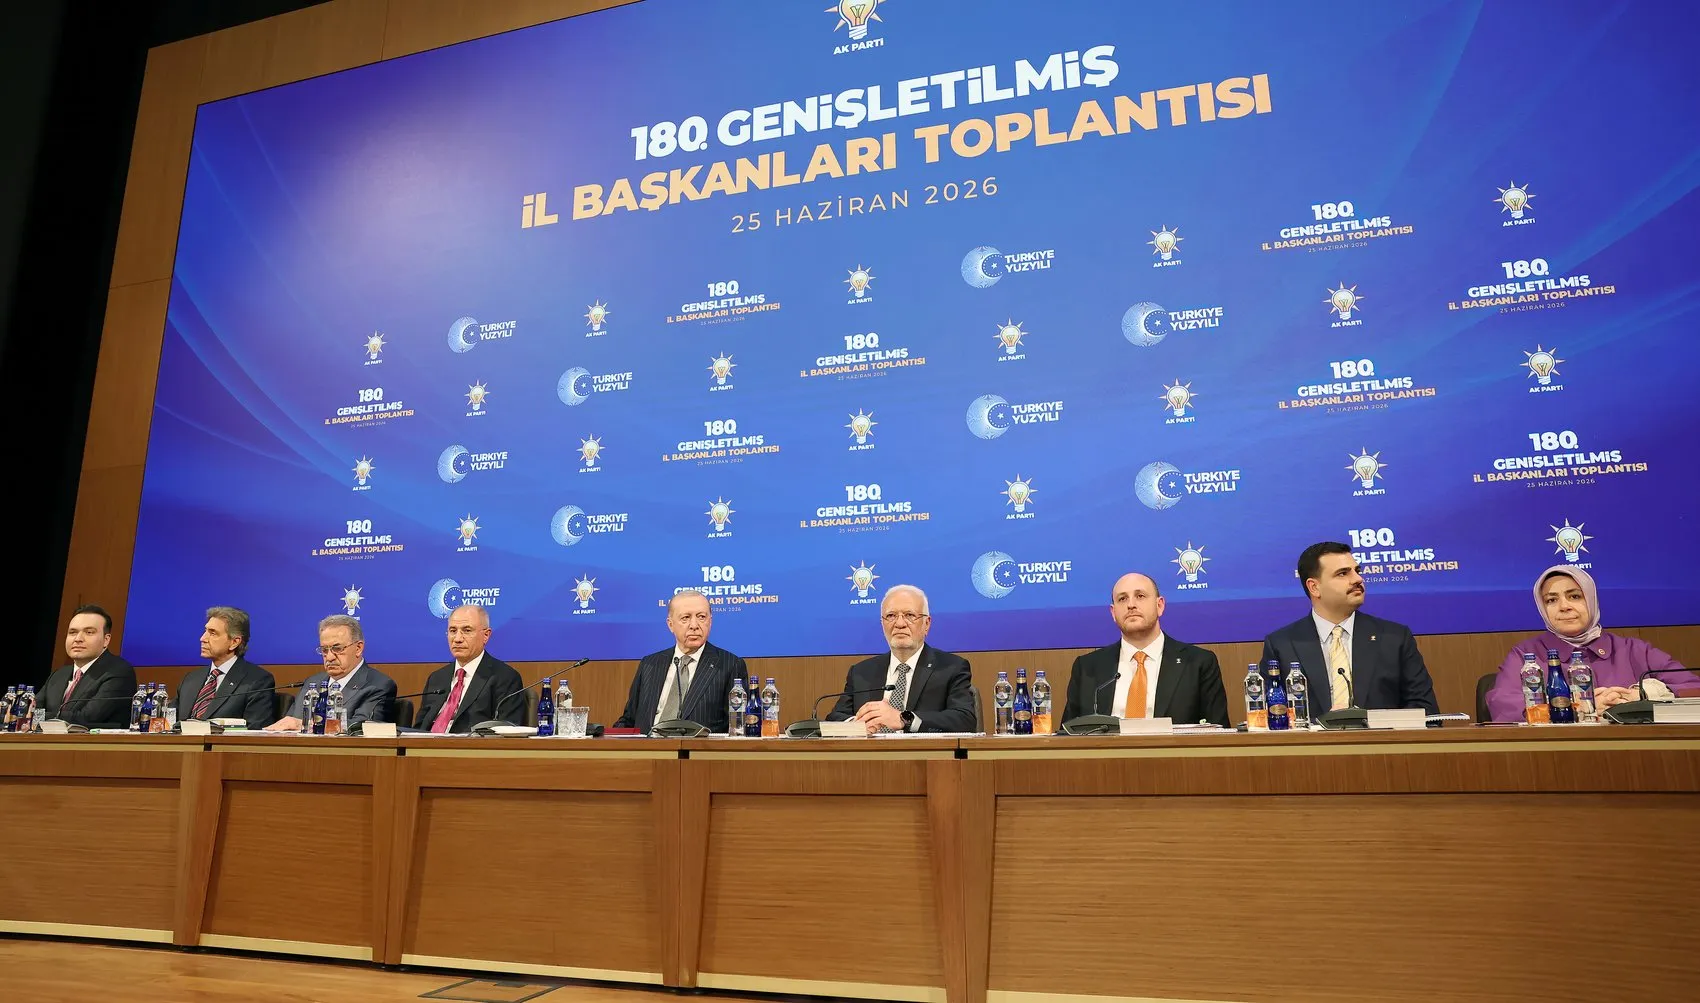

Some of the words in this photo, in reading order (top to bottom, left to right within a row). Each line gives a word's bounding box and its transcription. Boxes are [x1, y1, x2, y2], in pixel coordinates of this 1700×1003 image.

[833, 44, 850, 55] AK
[851, 37, 884, 52] PARTİ
[630, 116, 708, 161] 180.
[717, 44, 1120, 147] GENİŞLETİLMİŞ
[521, 192, 559, 229] İL
[572, 132, 897, 221] BAŞKANLARI
[914, 73, 1272, 163] TOPLANTISI
[731, 212, 761, 233] 25
[775, 190, 909, 228] HAZİRAN
[924, 177, 998, 205] 2026
[1274, 233, 1344, 249] BAŞKANLARI
[1346, 225, 1413, 240] TOPLANTISI
[1461, 293, 1539, 309] BAŞKANLARI
[1541, 285, 1616, 301] TOPLANTISI
[1291, 394, 1364, 408] BAŞKANLARI
[1366, 387, 1436, 401] TOPLANTISI
[1487, 468, 1568, 482] BAŞKANLARI
[1570, 462, 1648, 476] TOPLANTISI
[1387, 561, 1459, 573] TOPLANTISI
[726, 595, 779, 604] TOPLANTISI
